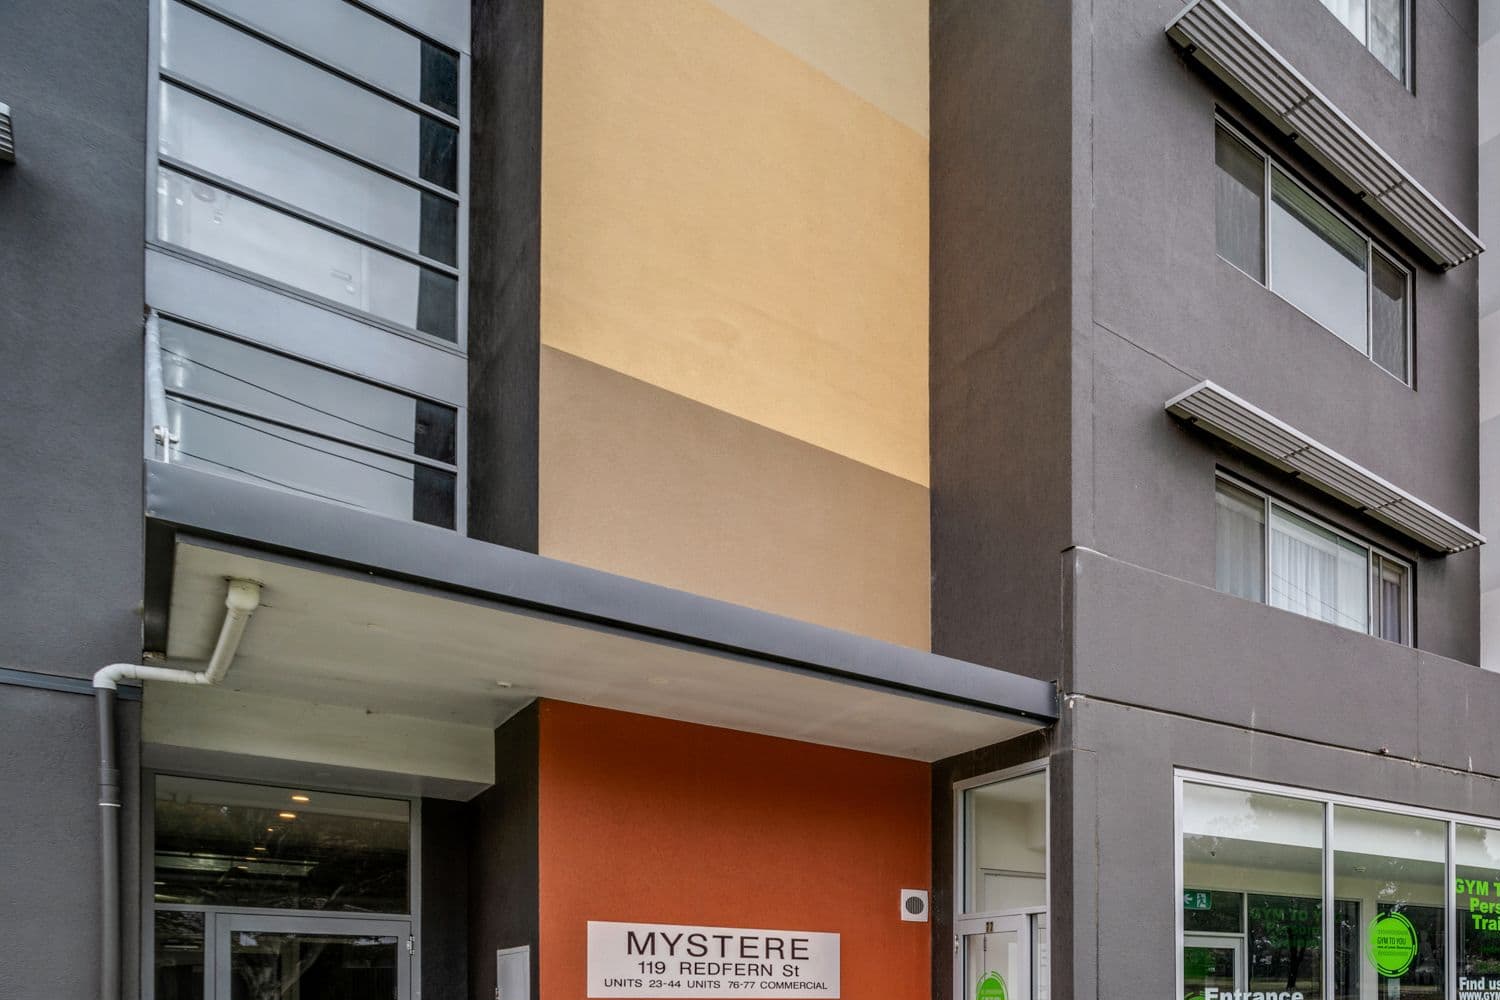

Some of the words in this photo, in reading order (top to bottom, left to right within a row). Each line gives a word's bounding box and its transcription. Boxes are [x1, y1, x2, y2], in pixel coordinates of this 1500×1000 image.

[1456, 878, 1489, 896] GYM
[626, 931, 810, 960] MYSTERE
[638, 961, 666, 975] 119
[679, 962, 773, 977] REDFERN
[782, 964, 800, 978] St
[604, 978, 643, 988] UNITS
[649, 979, 681, 988] 23-44
[687, 980, 721, 989] UNITS
[727, 980, 756, 989] 76-77
[760, 981, 828, 990] COMMERCIAL
[1458, 976, 1485, 991] Find
